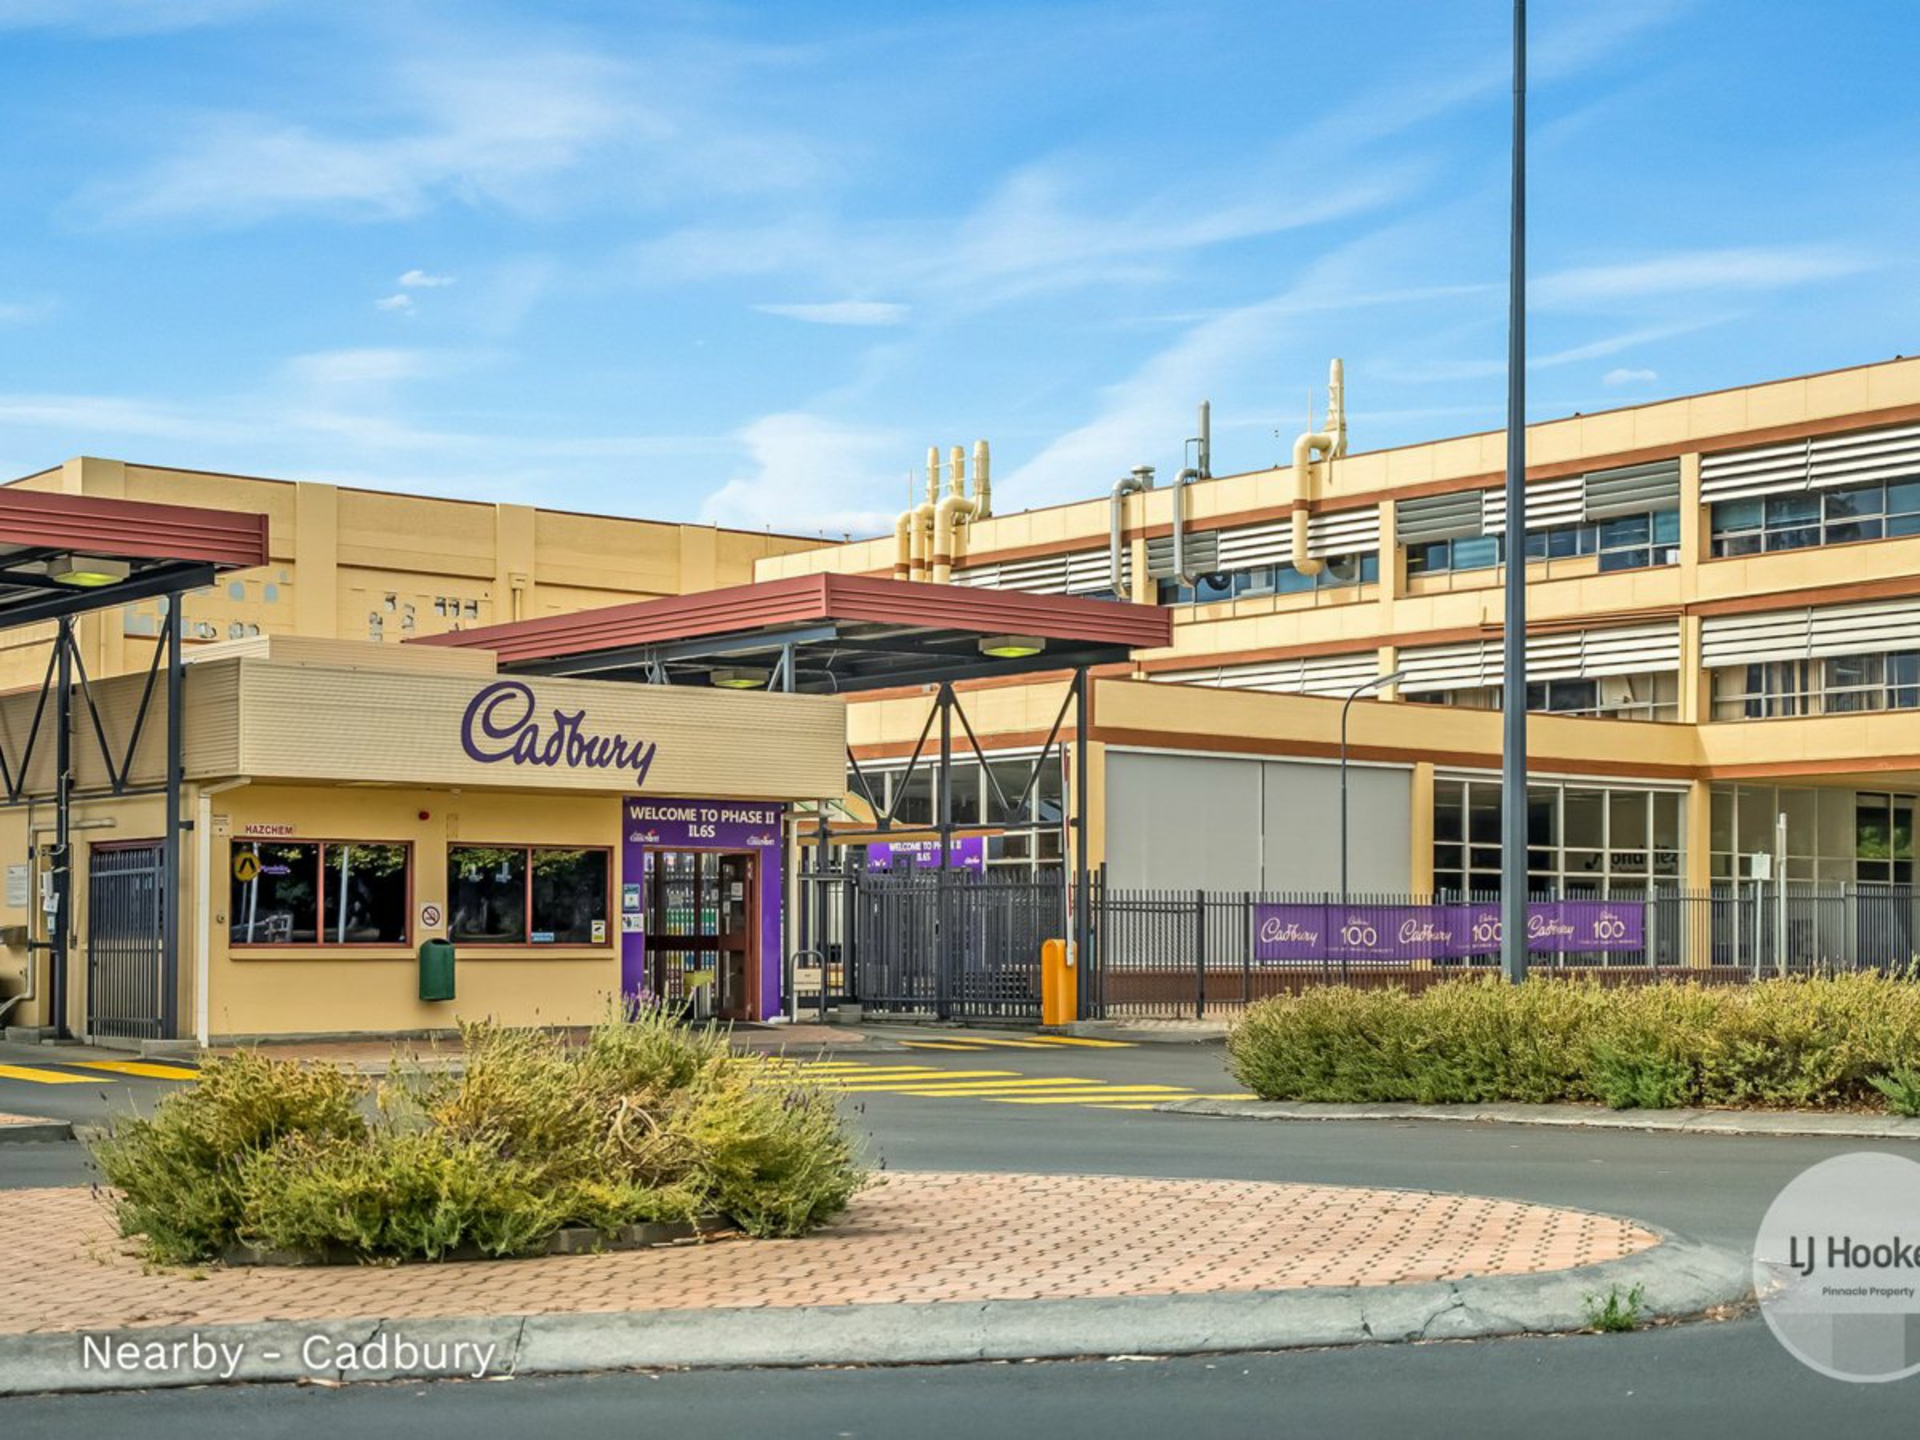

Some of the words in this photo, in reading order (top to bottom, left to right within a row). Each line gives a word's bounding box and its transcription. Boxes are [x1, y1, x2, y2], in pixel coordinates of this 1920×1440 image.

[461, 681, 656, 787] Cadbury
[630, 806, 697, 822] WELCOME
[700, 809, 718, 822] TO
[721, 809, 762, 824] PHASE
[245, 824, 294, 835] HAZCHEM
[889, 841, 921, 852] WELCOME
[922, 841, 932, 851] TO
[1260, 917, 1318, 947] Cadbury
[1341, 926, 1377, 946] 100
[1399, 919, 1452, 946] Cadbury
[1472, 923, 1502, 942] 100
[1527, 915, 1574, 940] Cadbury
[1593, 920, 1626, 939] 100
